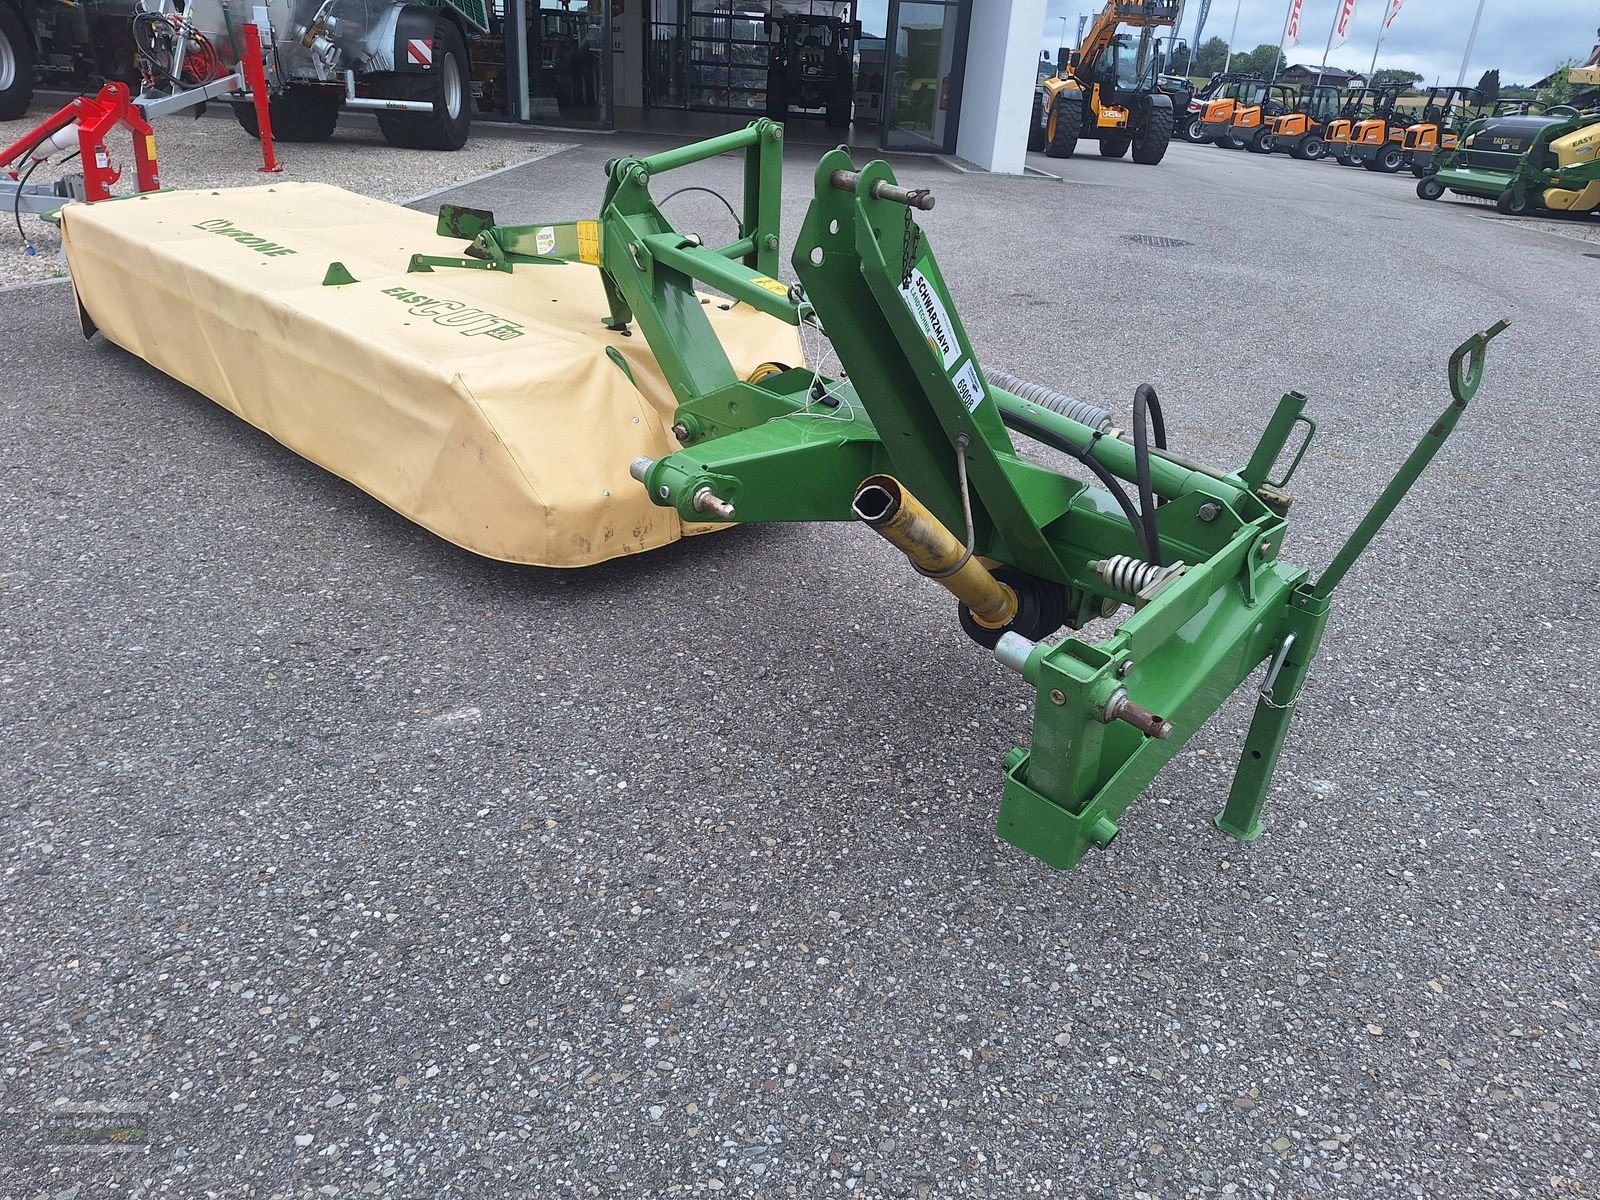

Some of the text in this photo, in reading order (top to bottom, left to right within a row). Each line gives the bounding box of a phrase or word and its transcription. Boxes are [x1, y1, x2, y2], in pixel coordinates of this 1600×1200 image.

[1572, 135, 1593, 147] EASY
[909, 286, 932, 336] LANDTECHNIK
[915, 276, 951, 356] SCHWARZMAYR
[956, 377, 975, 411] 69008
